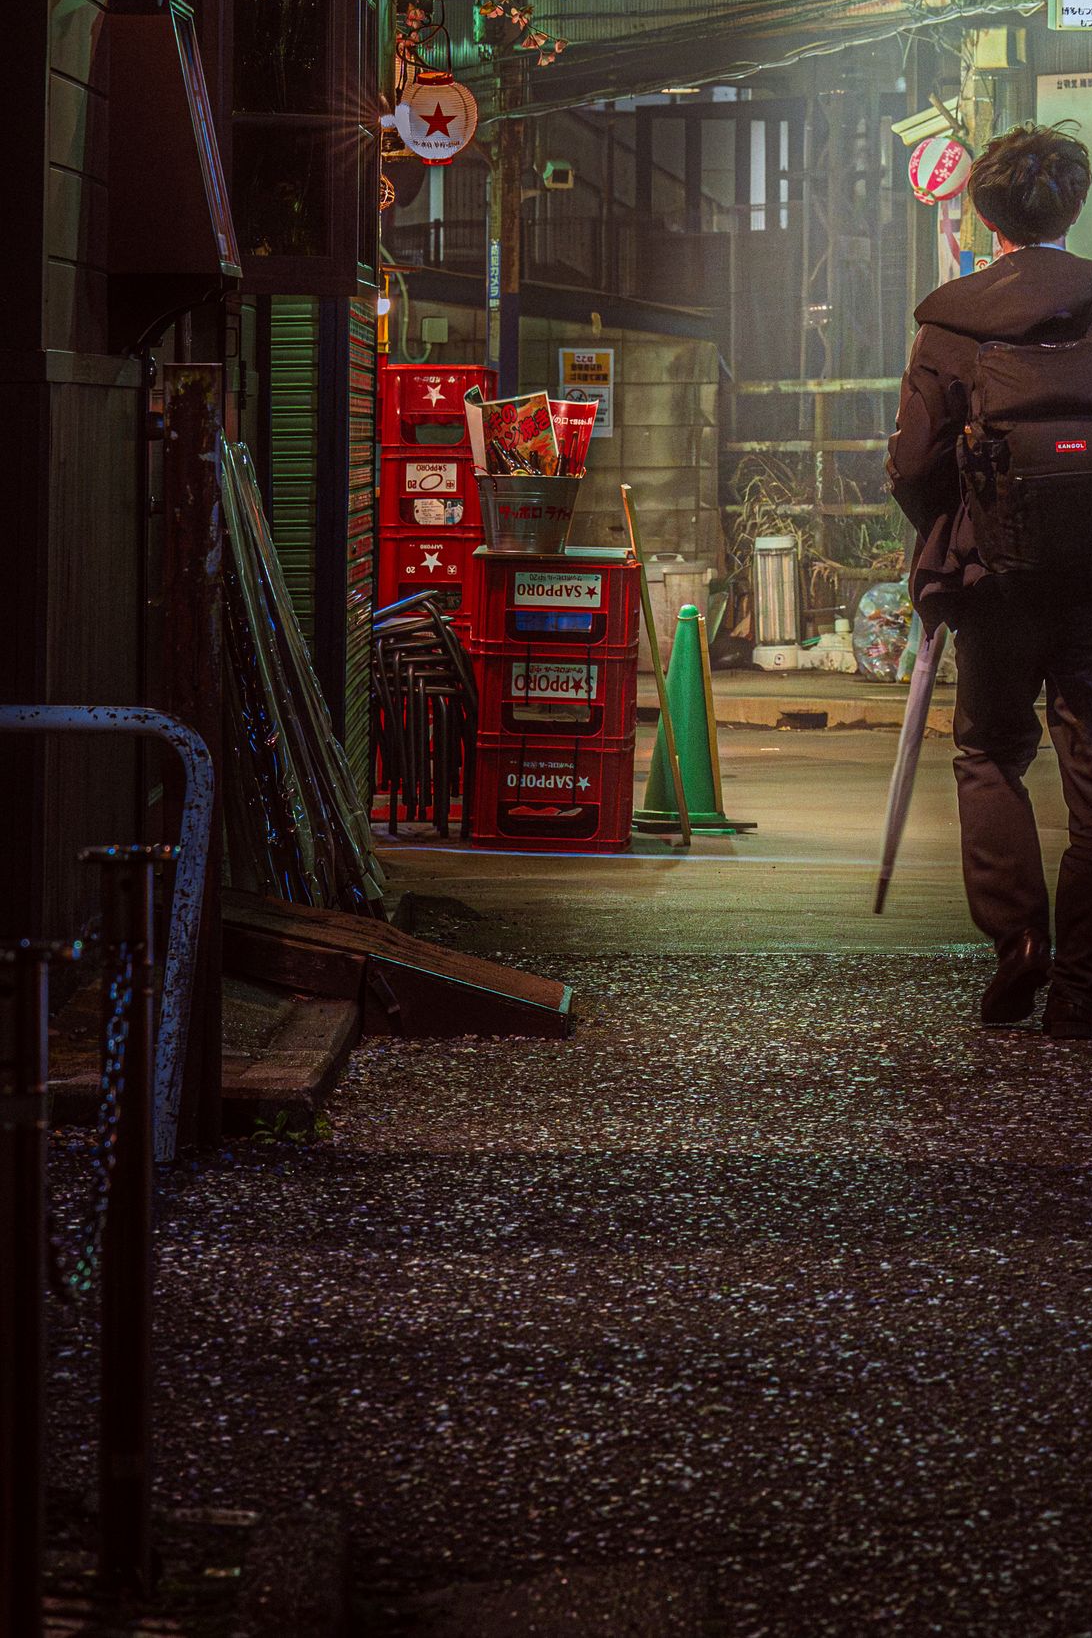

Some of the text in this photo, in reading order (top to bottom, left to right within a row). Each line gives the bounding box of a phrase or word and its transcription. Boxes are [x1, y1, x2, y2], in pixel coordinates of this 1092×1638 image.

[416, 464, 448, 472] SPPORO
[499, 505, 543, 521] サッポロ
[405, 566, 416, 574] 20
[517, 584, 583, 598] SAPPORO
[514, 673, 595, 694] SPPORO
[506, 773, 575, 789] SAPPORO
